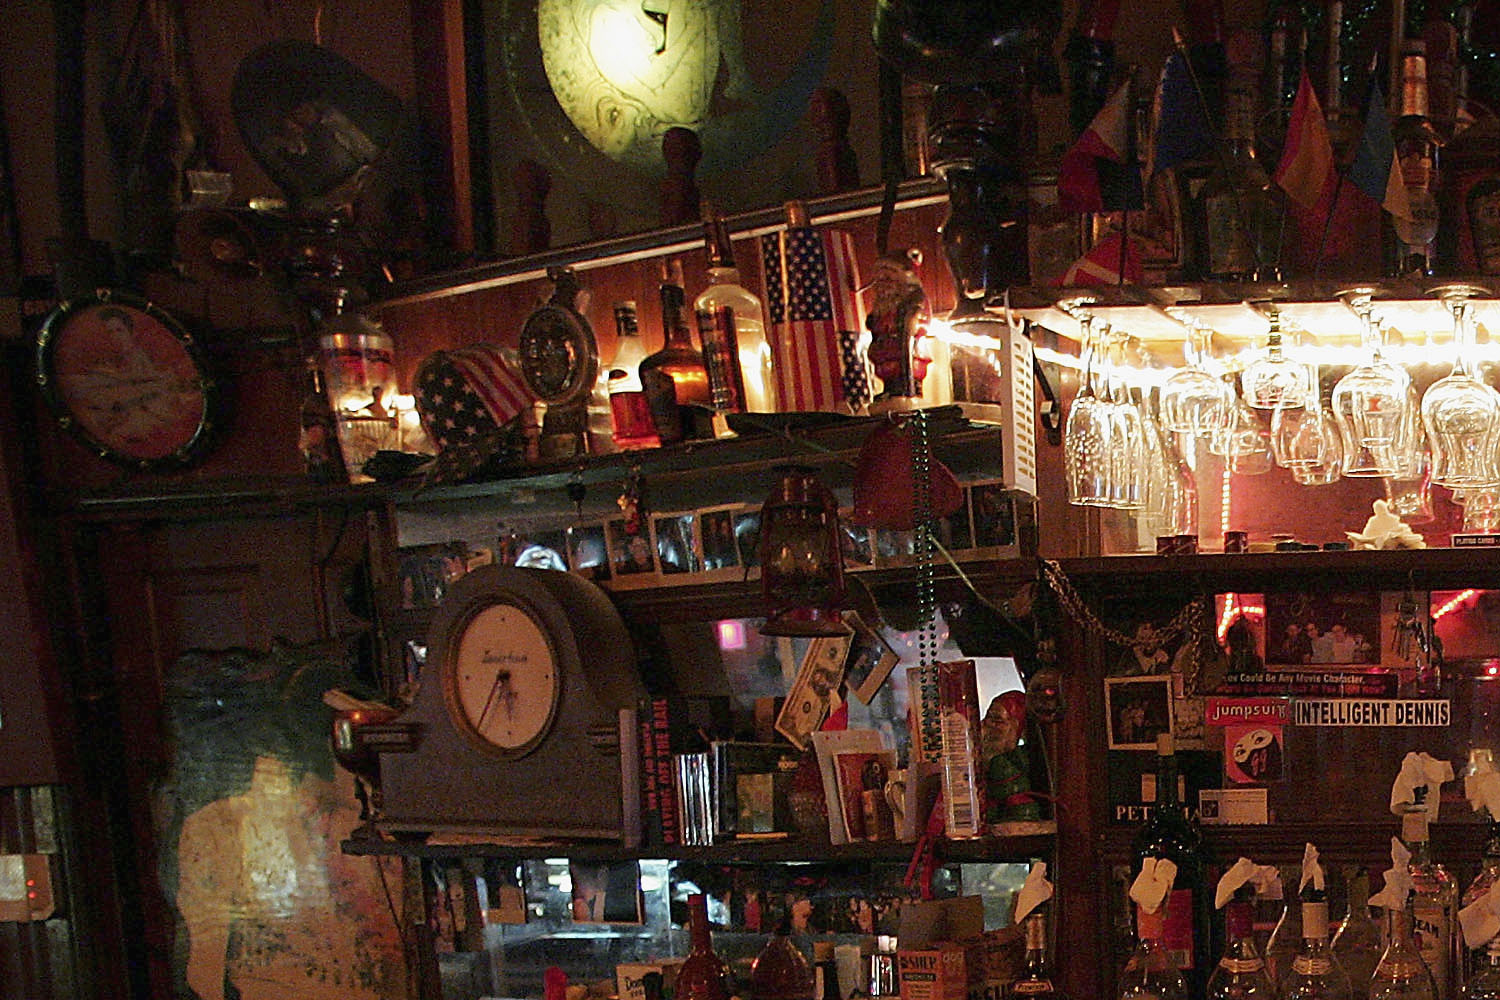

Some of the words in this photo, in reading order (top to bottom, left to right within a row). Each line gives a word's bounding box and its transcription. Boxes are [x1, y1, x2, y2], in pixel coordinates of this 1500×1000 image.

[1239, 673, 1264, 684] Could
[1265, 673, 1277, 684] Be
[1278, 674, 1295, 686] Any
[1295, 673, 1322, 684] Movie
[1296, 701, 1391, 725] INTELLIGENT
[1395, 701, 1449, 725] DENNIS
